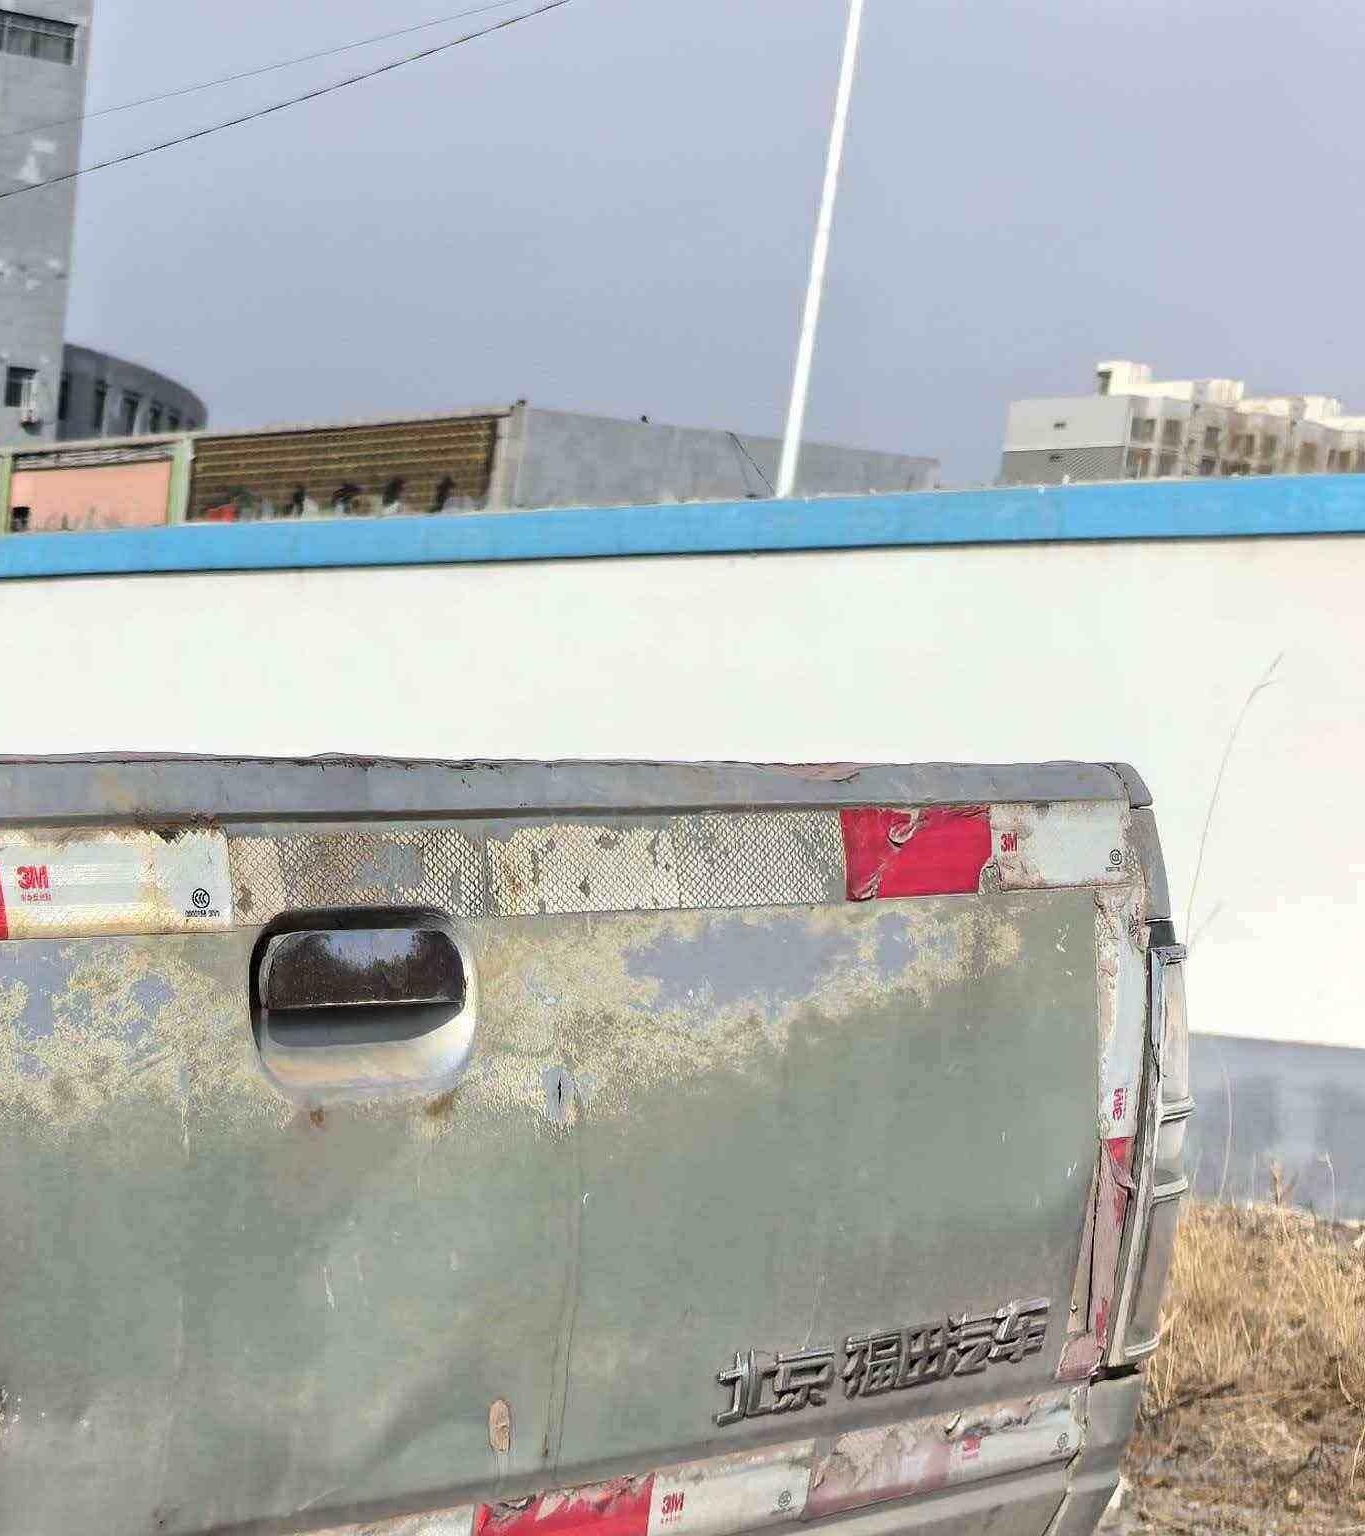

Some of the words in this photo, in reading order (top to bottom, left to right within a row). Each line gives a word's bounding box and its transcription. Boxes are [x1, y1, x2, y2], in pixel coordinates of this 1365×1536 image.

[16, 864, 50, 890] 3M
[713, 1297, 1051, 1426] 北京福田汽车
